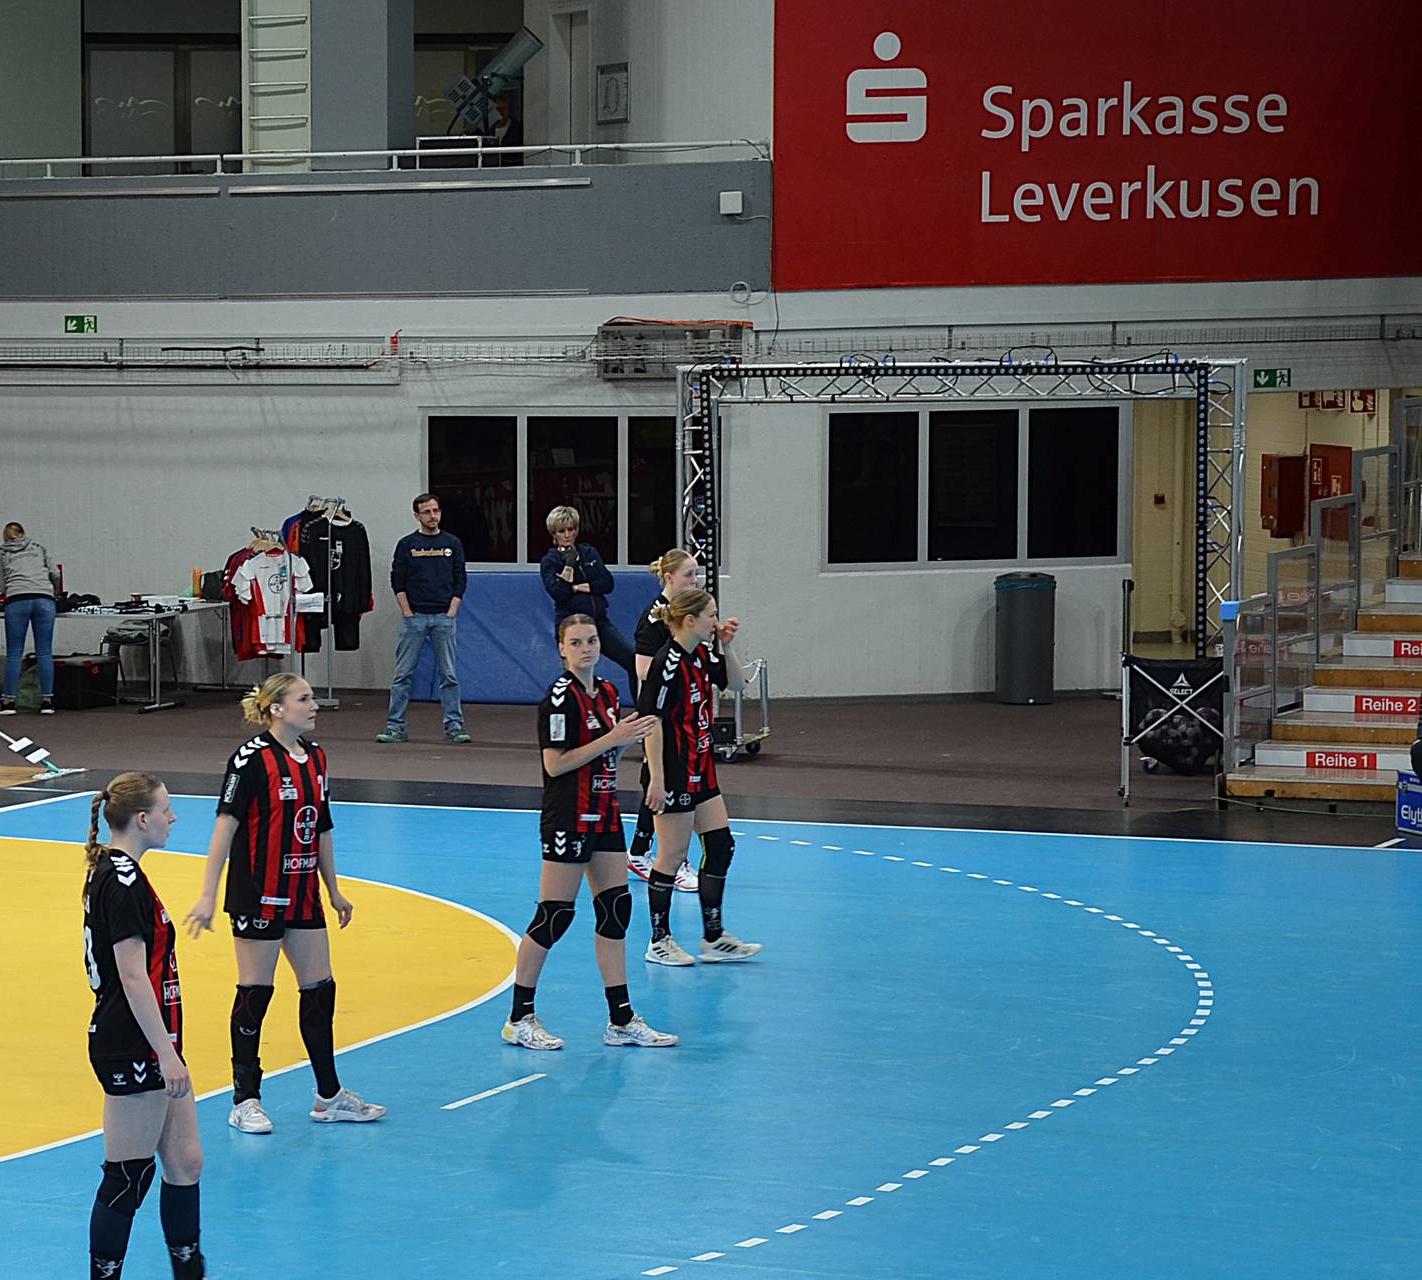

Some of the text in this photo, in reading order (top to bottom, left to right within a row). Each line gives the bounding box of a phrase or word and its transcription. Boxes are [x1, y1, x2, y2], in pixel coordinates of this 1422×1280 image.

[981, 81, 1288, 151] Sparkasse
[981, 165, 1319, 223] Leverkusen
[1170, 688, 1193, 696] SELECT
[1362, 698, 1417, 712] Reihe 2
[1315, 753, 1368, 767] Reihe 1
[1401, 805, 1422, 825] Elyt
